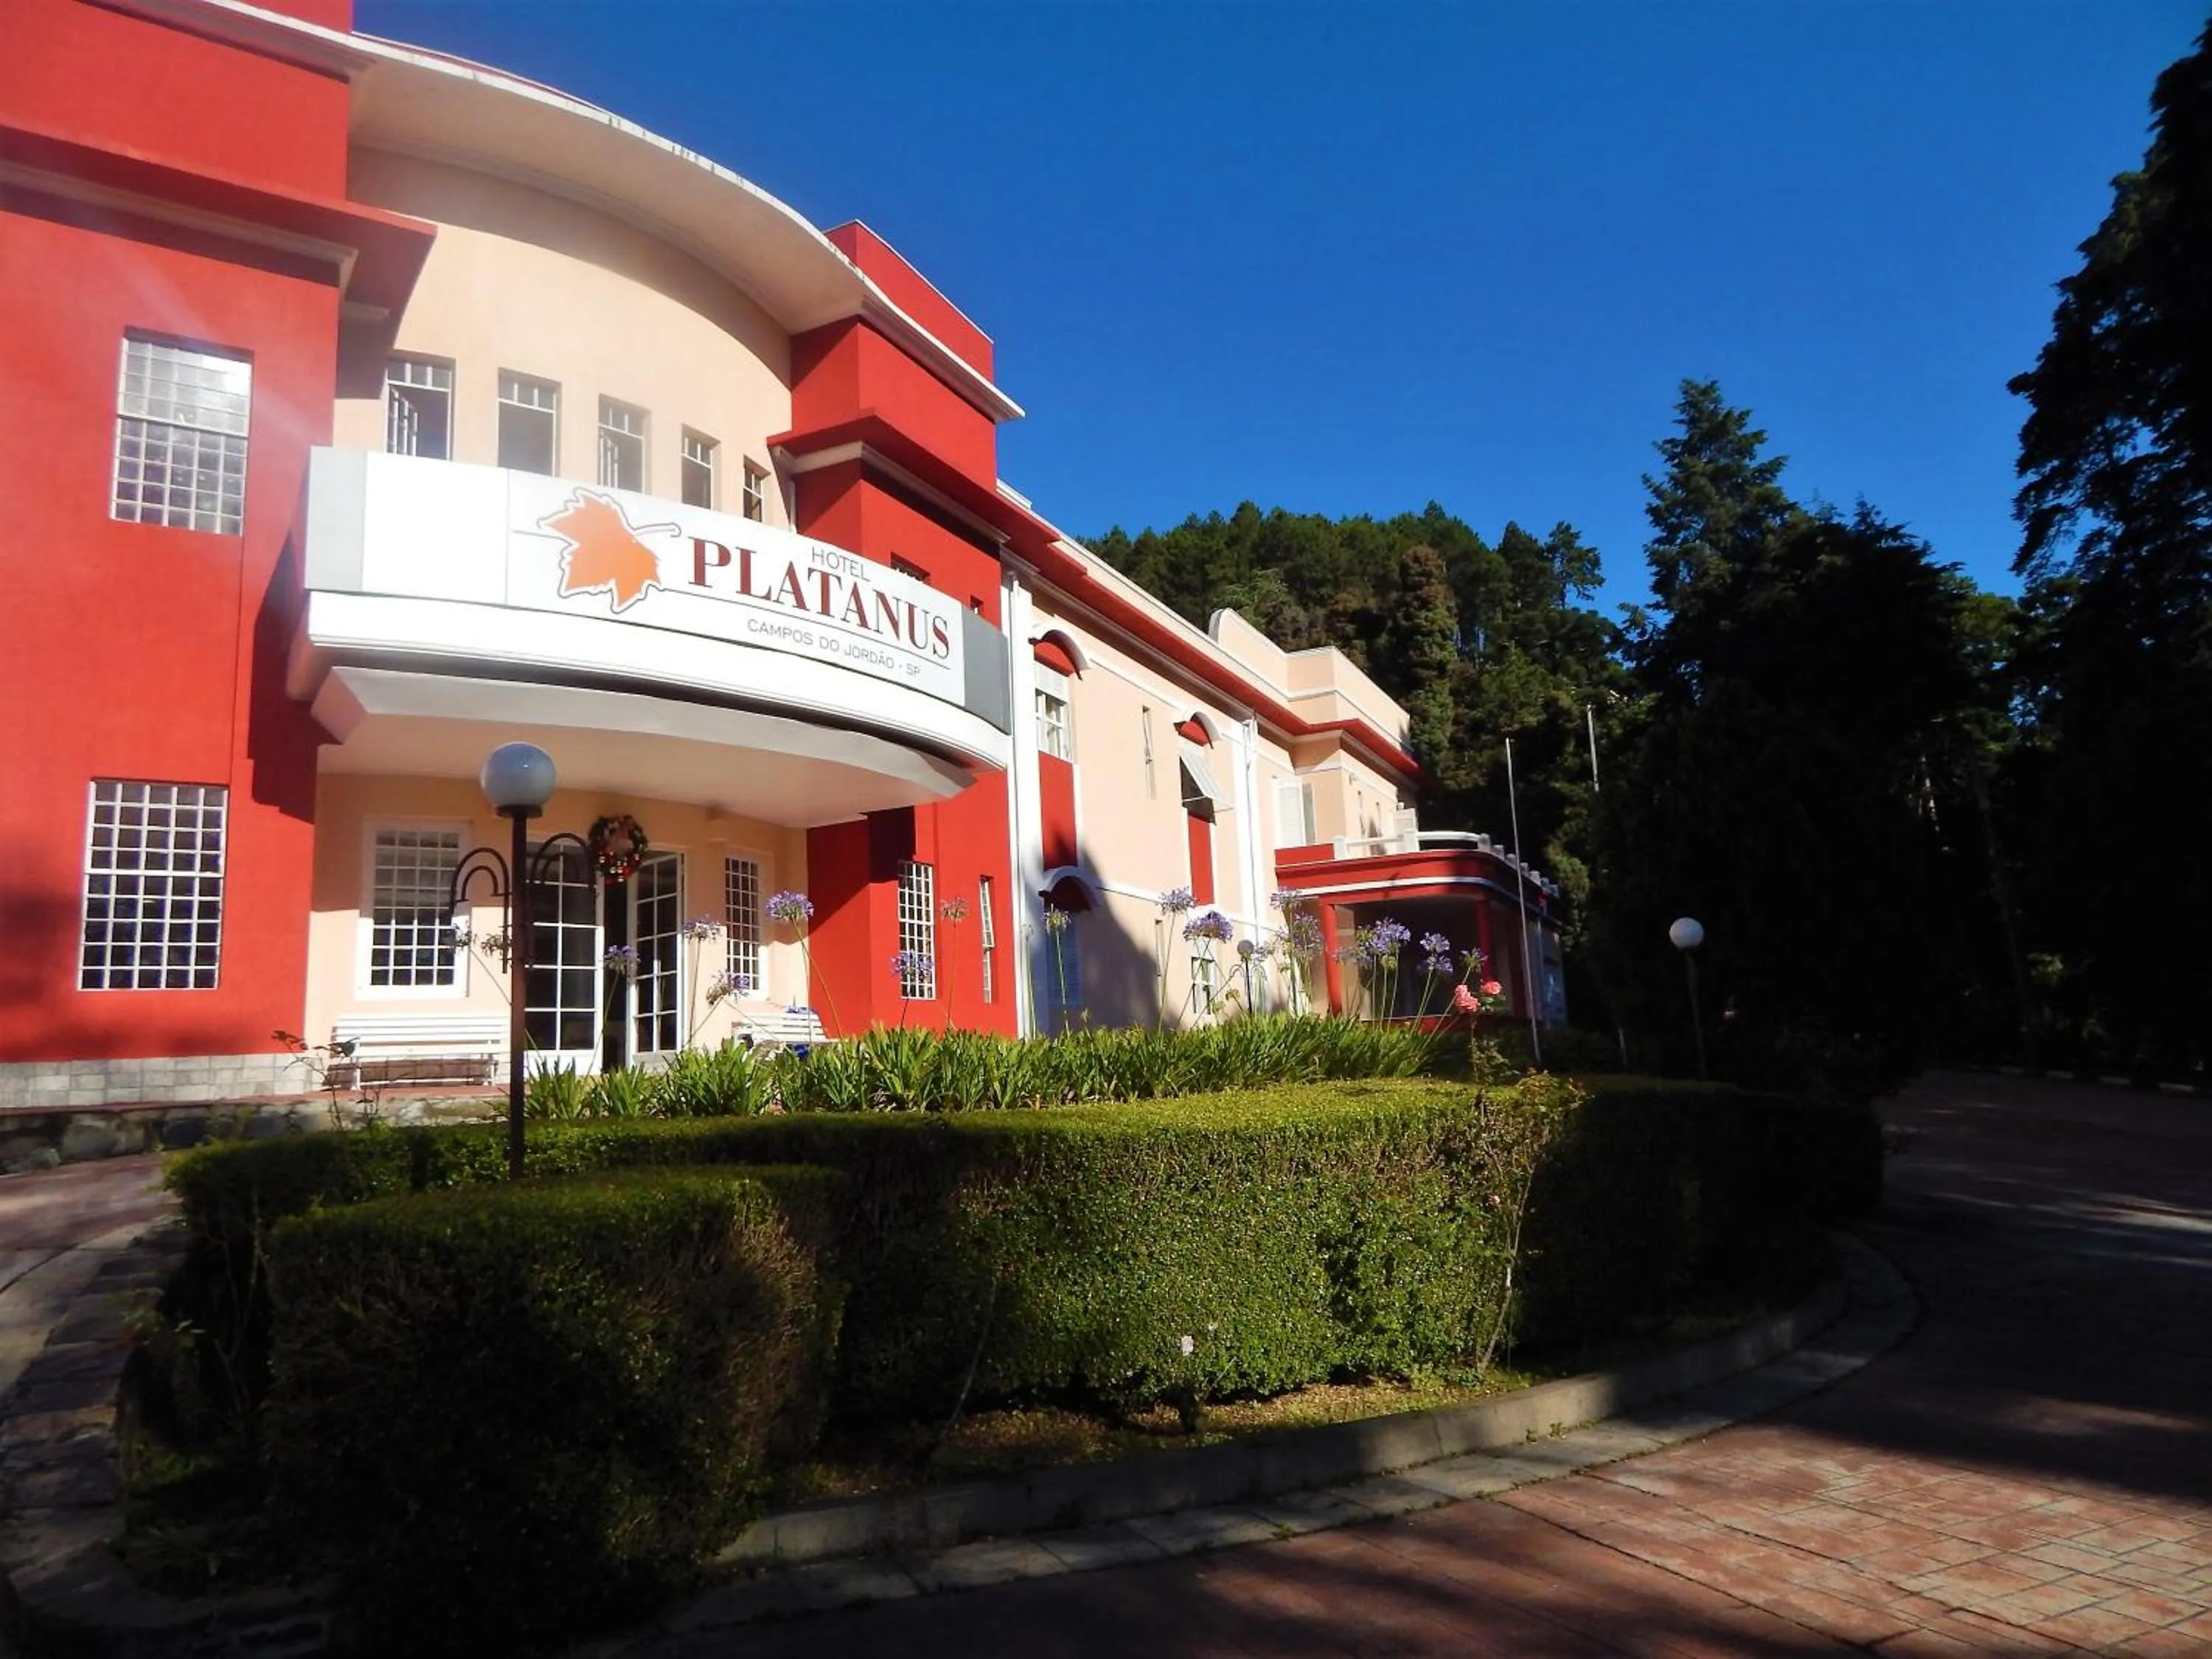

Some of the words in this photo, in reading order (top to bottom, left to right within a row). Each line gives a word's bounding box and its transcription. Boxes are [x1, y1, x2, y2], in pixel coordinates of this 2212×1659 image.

[812, 546, 870, 581] HOTEL
[688, 537, 950, 658] PLATANUS
[747, 619, 813, 645] CAMPOS
[819, 636, 840, 652] DO
[844, 644, 894, 669] JORDÃO
[906, 663, 921, 677] SP
